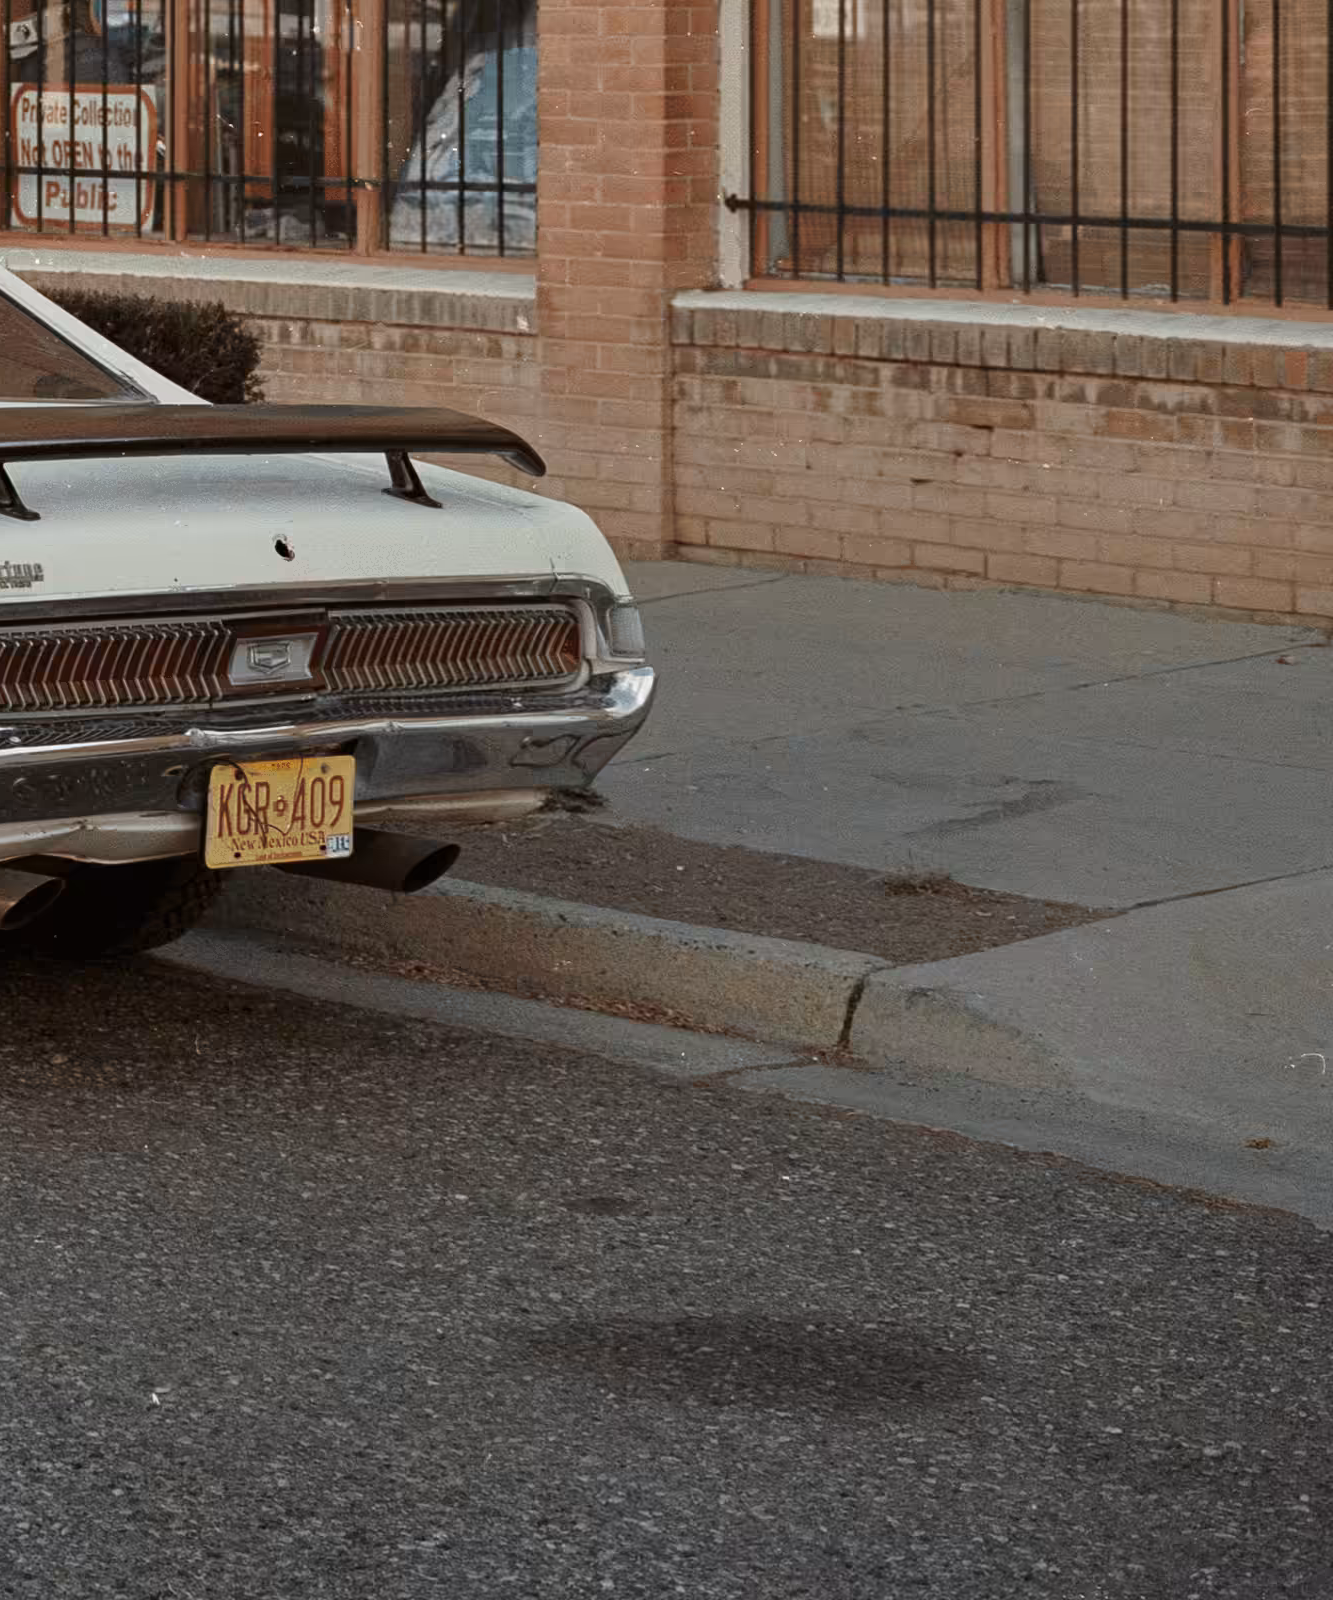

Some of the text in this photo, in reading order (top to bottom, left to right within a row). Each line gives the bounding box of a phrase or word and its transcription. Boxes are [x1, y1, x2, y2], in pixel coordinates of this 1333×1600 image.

[21, 97, 67, 125] Prvate
[20, 138, 47, 166] Not
[51, 140, 94, 168] OPEN
[45, 180, 118, 211] Public
[217, 781, 270, 838] KGR
[231, 830, 326, 851] New Mexico USA
